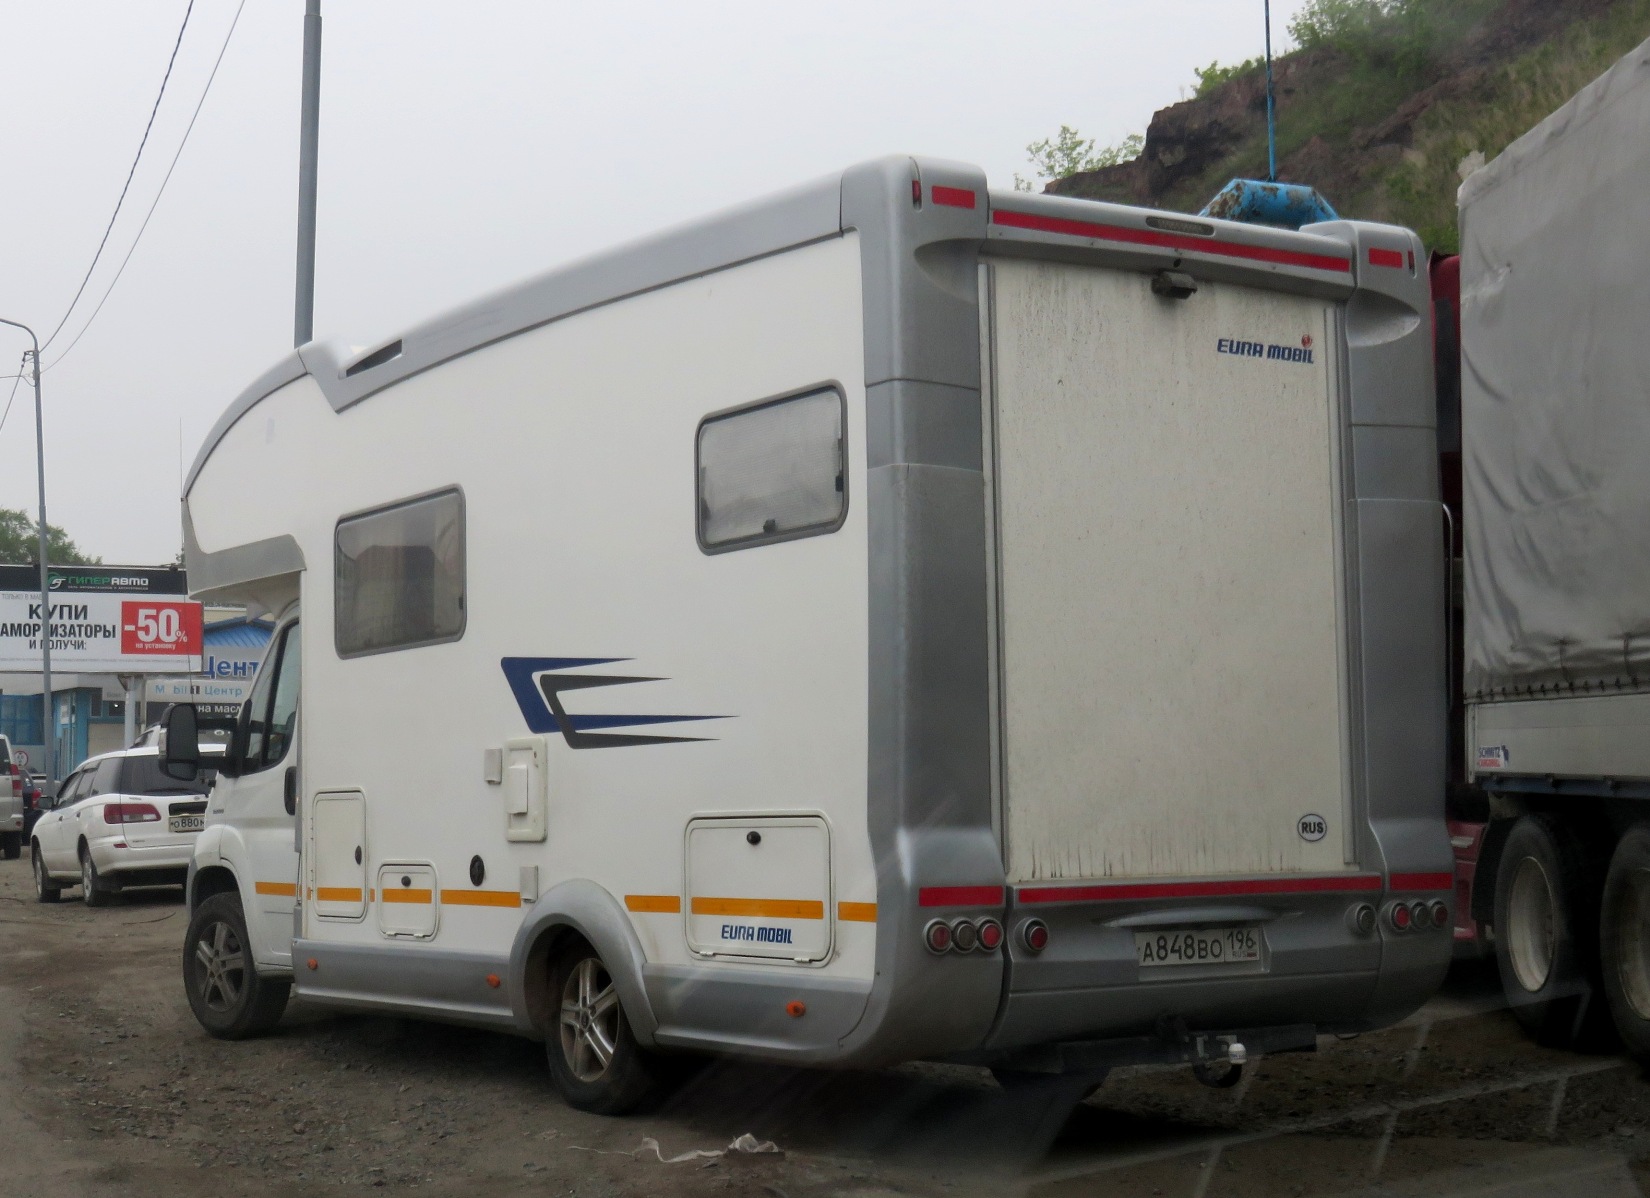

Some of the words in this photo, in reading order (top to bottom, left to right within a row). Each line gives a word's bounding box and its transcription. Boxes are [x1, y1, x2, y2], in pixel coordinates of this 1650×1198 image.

[1217, 338, 1264, 358] EURA
[1267, 344, 1314, 364] MOBIL
[29, 604, 88, 620] КУПИ
[0, 623, 116, 638] АМОРИЗАТОРЫ
[29, 640, 37, 649] И
[155, 685, 187, 694] Mbil
[204, 686, 242, 697] Центр
[1301, 822, 1324, 834] RUS
[721, 924, 755, 941] EURA
[757, 927, 792, 944] MOBIL
[1227, 930, 1254, 950] 196
